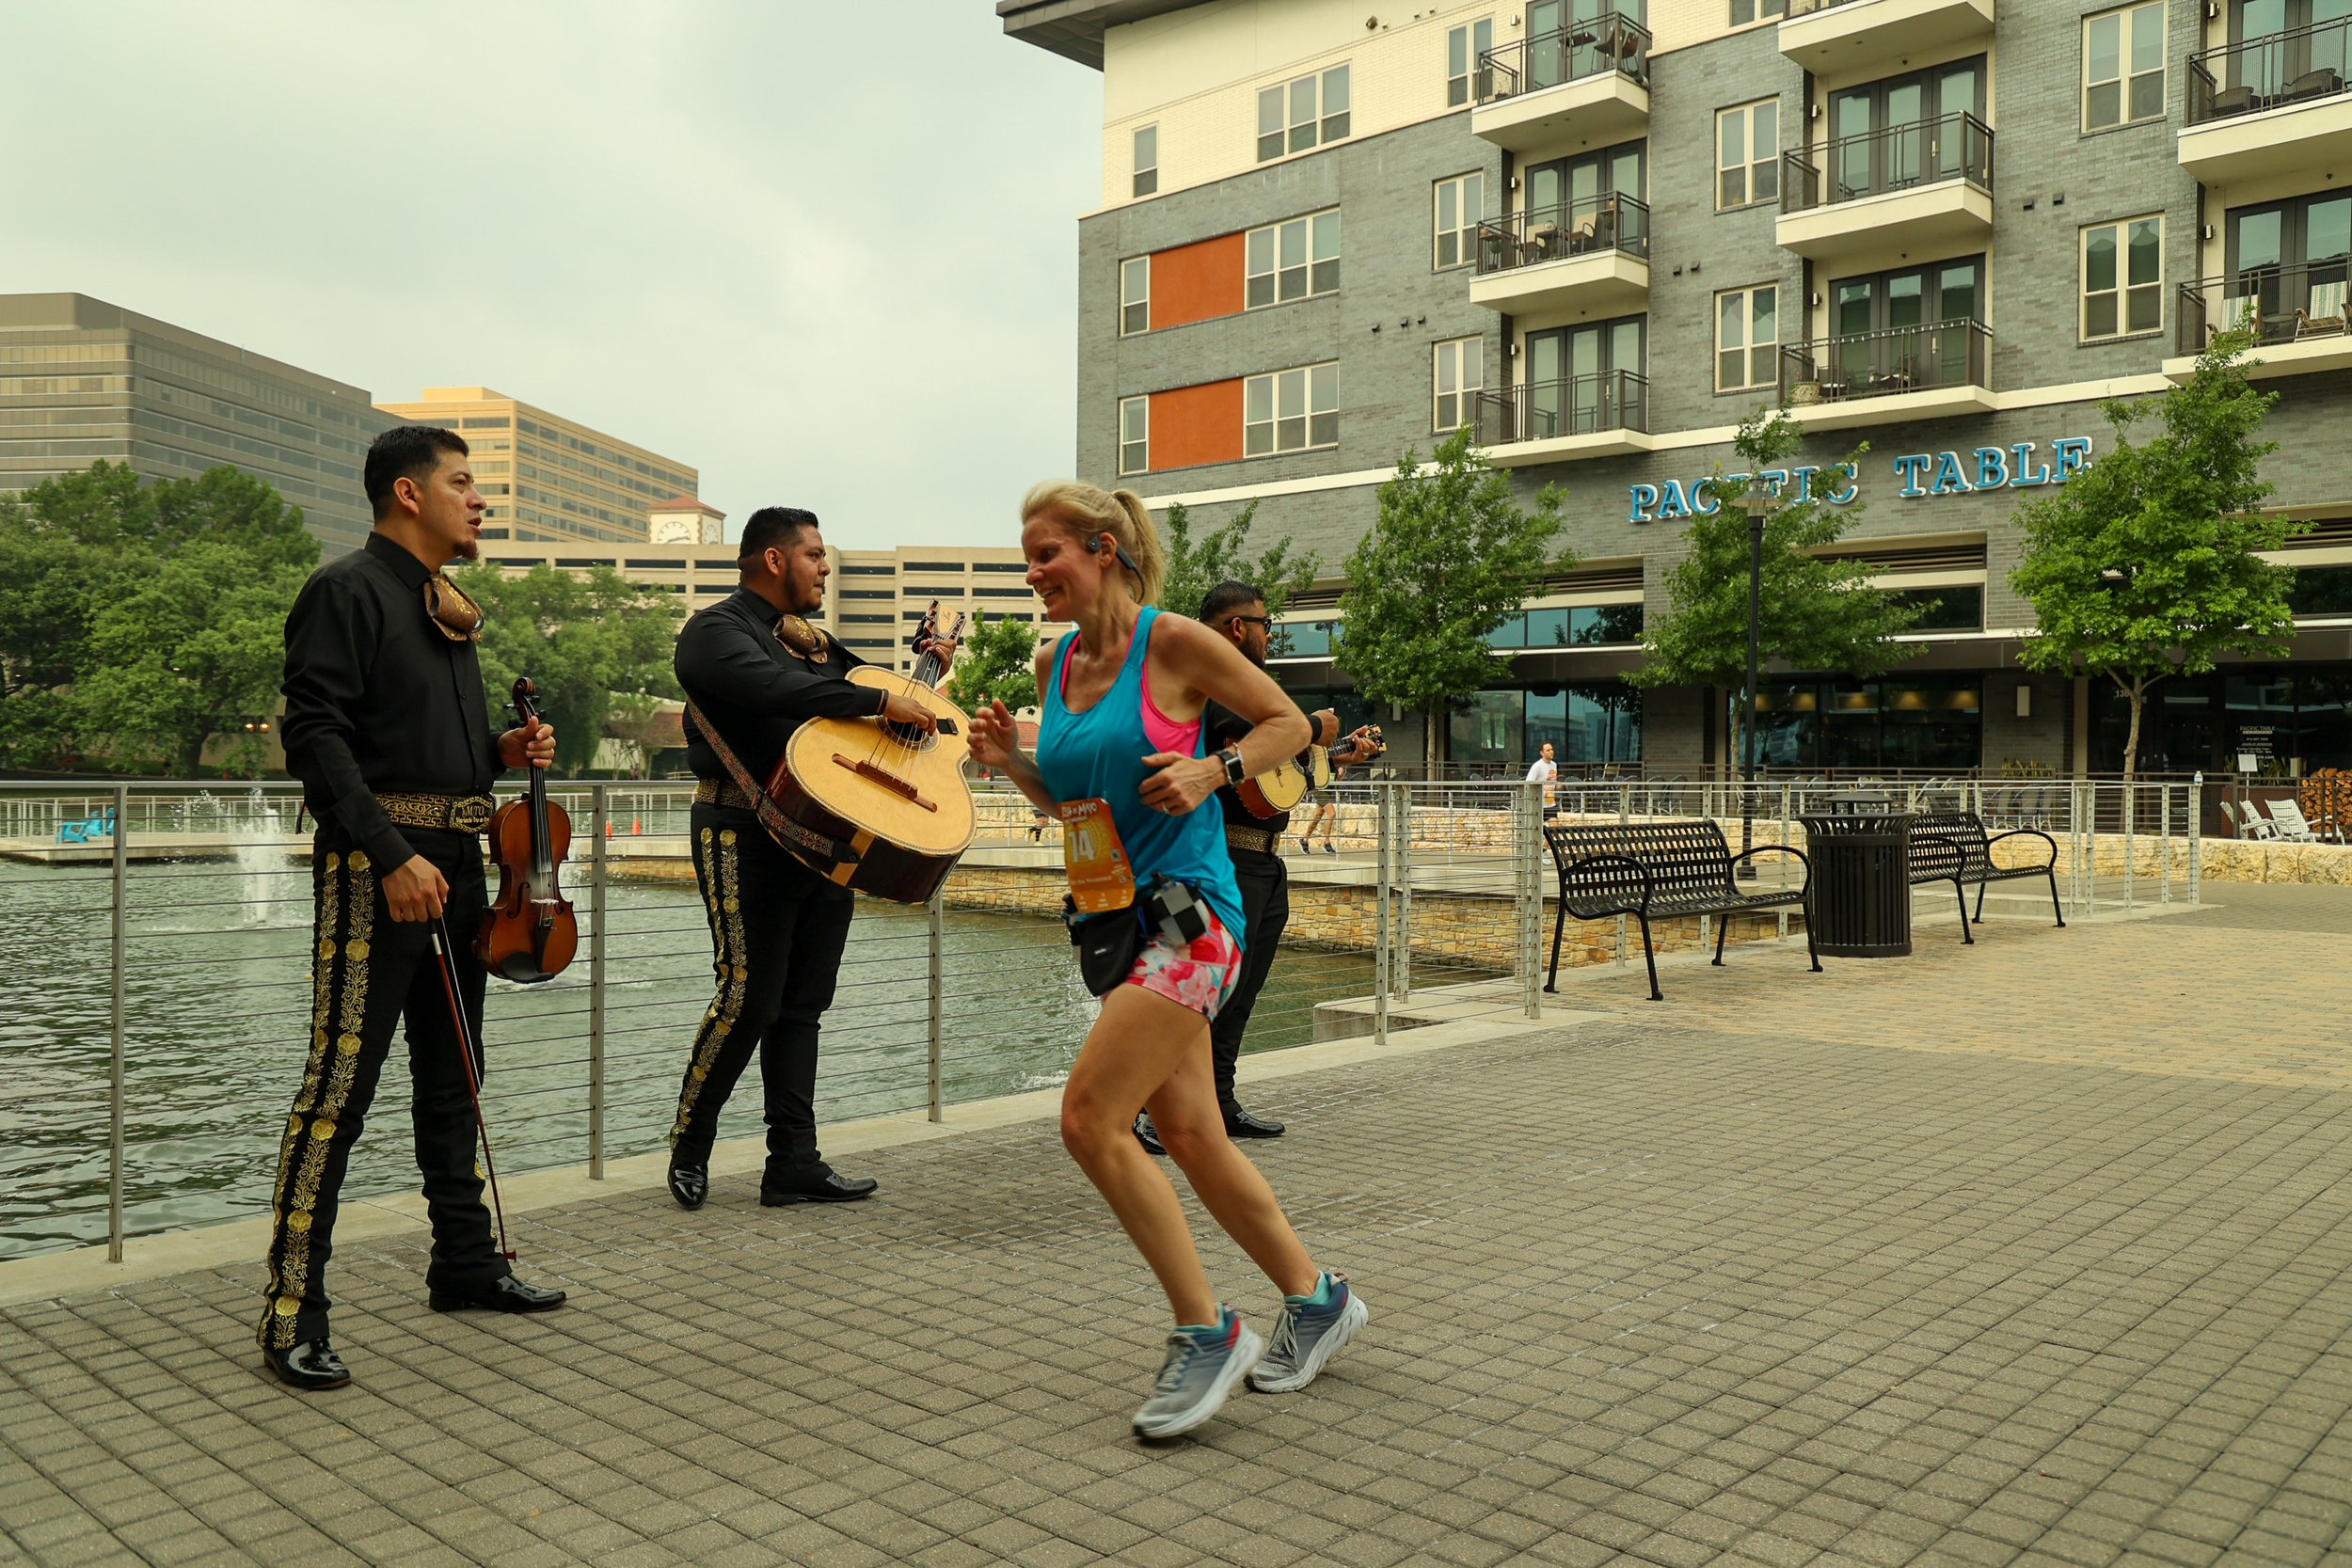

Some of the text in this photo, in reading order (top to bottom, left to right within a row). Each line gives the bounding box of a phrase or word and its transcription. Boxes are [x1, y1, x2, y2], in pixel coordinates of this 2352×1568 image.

[1628, 436, 2093, 523] PACFIC TABLE
[1068, 830, 1095, 863] 14
